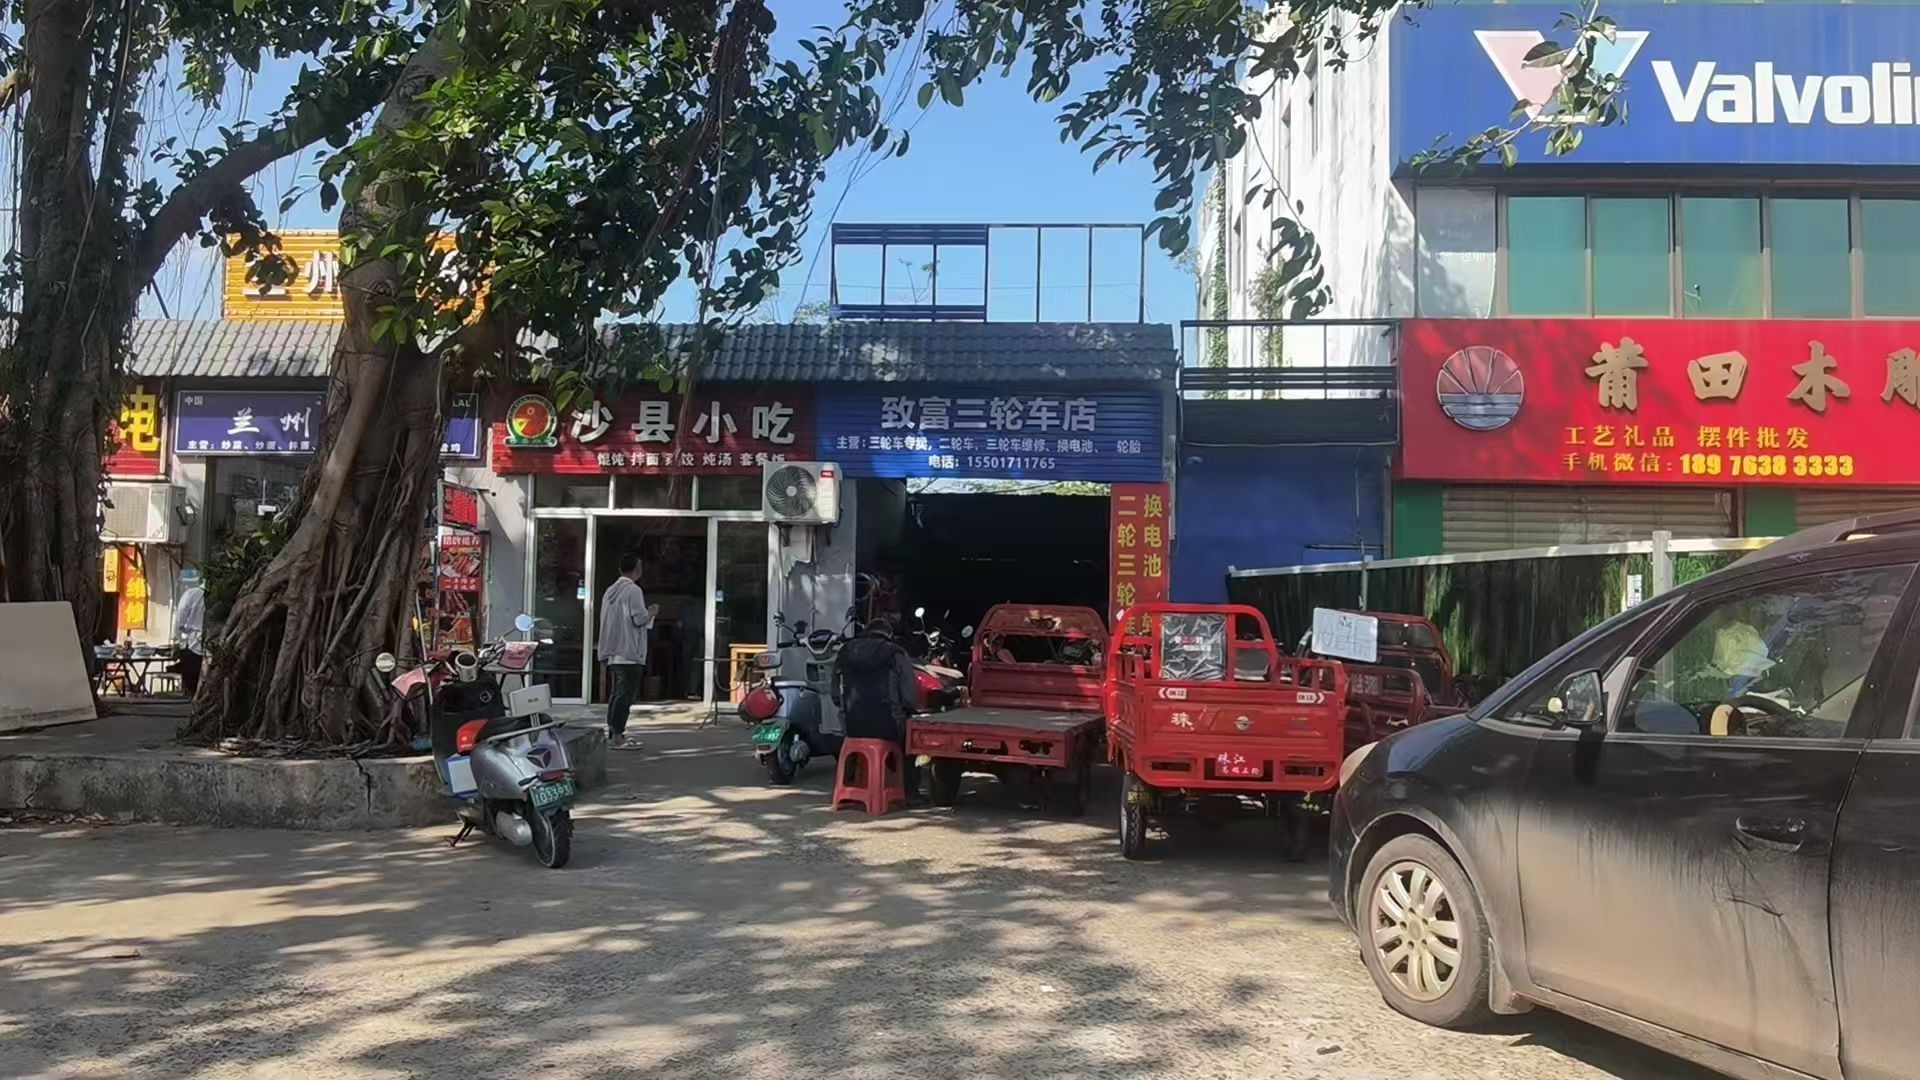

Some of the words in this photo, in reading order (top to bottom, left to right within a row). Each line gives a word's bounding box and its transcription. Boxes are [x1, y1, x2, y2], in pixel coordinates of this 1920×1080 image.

[1651, 61, 1920, 125] Valvoli
[227, 407, 312, 438] 兰州
[570, 399, 796, 444] 沙县小吃
[881, 396, 1098, 431] 致富三轮车店
[1116, 440, 1142, 454] 轮胎
[1565, 425, 1675, 448] 工艺礼品
[1697, 425, 1809, 449] 摆件批发
[702, 452, 732, 467] 炖汤
[1729, 454, 1787, 476] 7638
[1793, 455, 1854, 476] 3333
